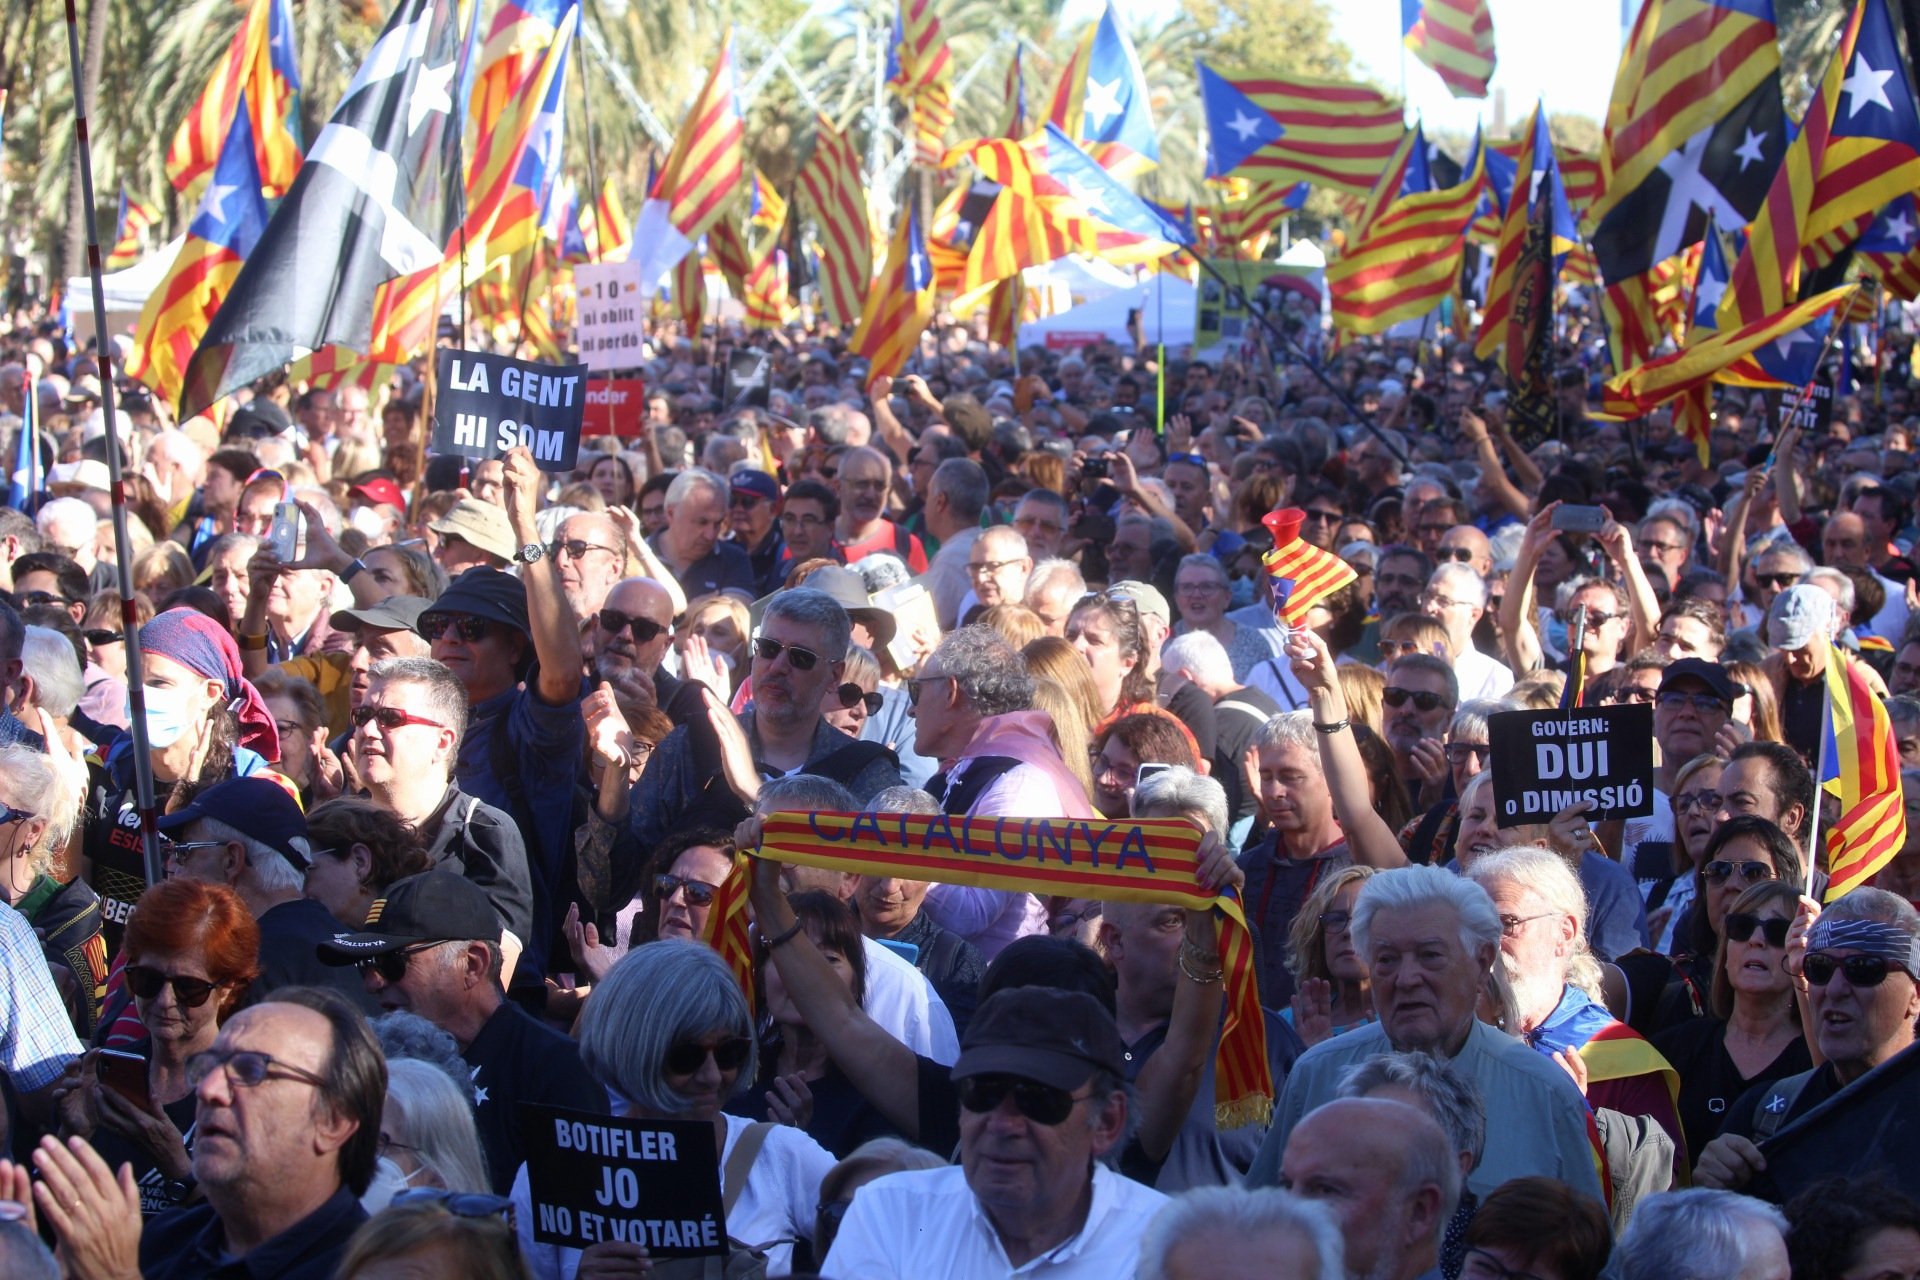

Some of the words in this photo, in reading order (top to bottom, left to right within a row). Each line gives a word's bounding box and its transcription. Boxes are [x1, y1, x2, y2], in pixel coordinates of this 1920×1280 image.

[450, 359, 490, 393] LA
[501, 366, 579, 407] GENT
[453, 413, 488, 448] HI
[496, 419, 565, 462] SOM
[1531, 718, 1609, 737] GOVERN:
[1535, 740, 1609, 780] DUI
[808, 811, 1155, 873] CATALUNYA
[554, 1118, 678, 1161] BOTIFLER
[595, 1166, 640, 1209] JO
[539, 1203, 573, 1236] NO
[579, 1210, 605, 1243] ET
[610, 1213, 720, 1248] VOTARÉ
